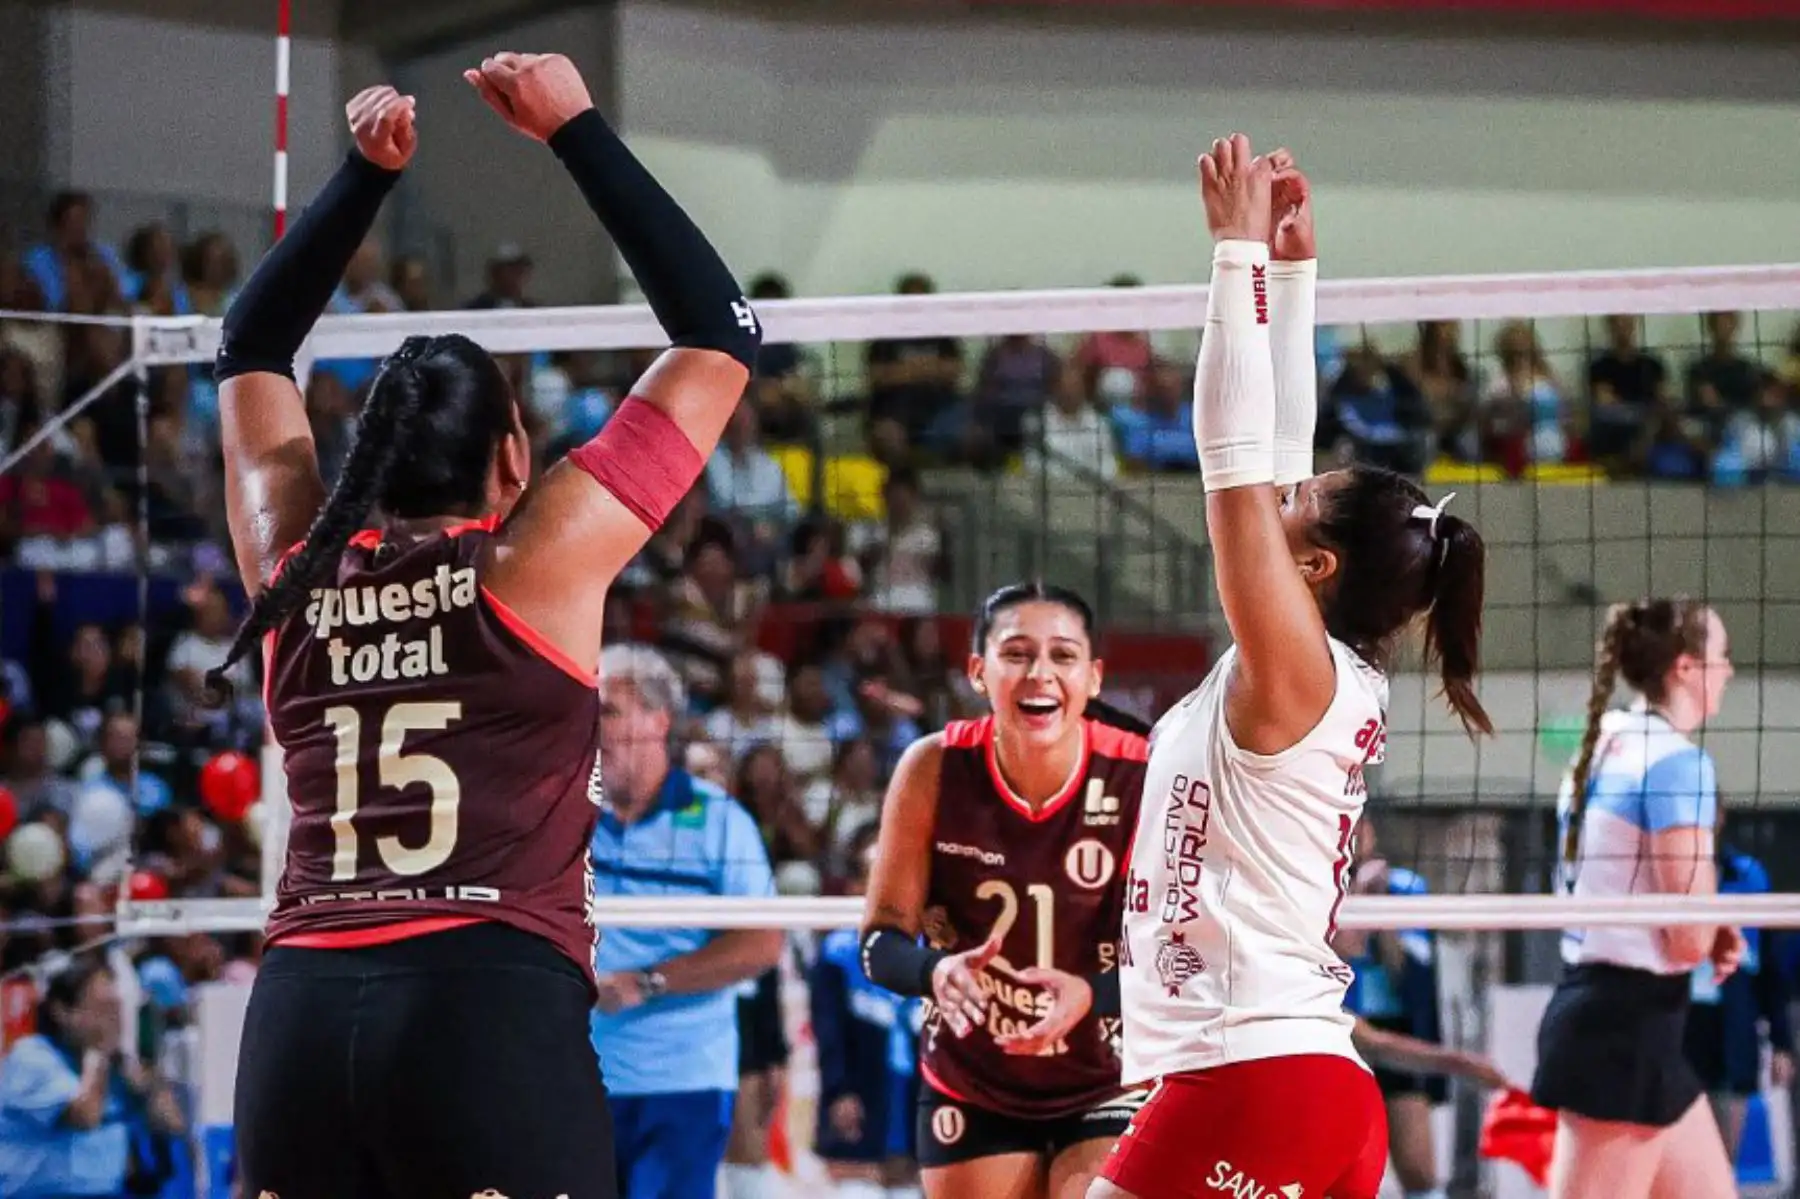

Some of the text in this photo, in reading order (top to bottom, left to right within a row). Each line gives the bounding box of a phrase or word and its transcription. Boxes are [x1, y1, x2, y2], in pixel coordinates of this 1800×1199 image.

[1252, 263, 1268, 324] MNBK
[305, 564, 476, 639] apuesta
[328, 624, 449, 686] total
[324, 701, 461, 881] 15
[1178, 780, 1210, 924] WORLD
[976, 880, 1054, 976] 21
[1206, 1160, 1278, 1199] SAN
